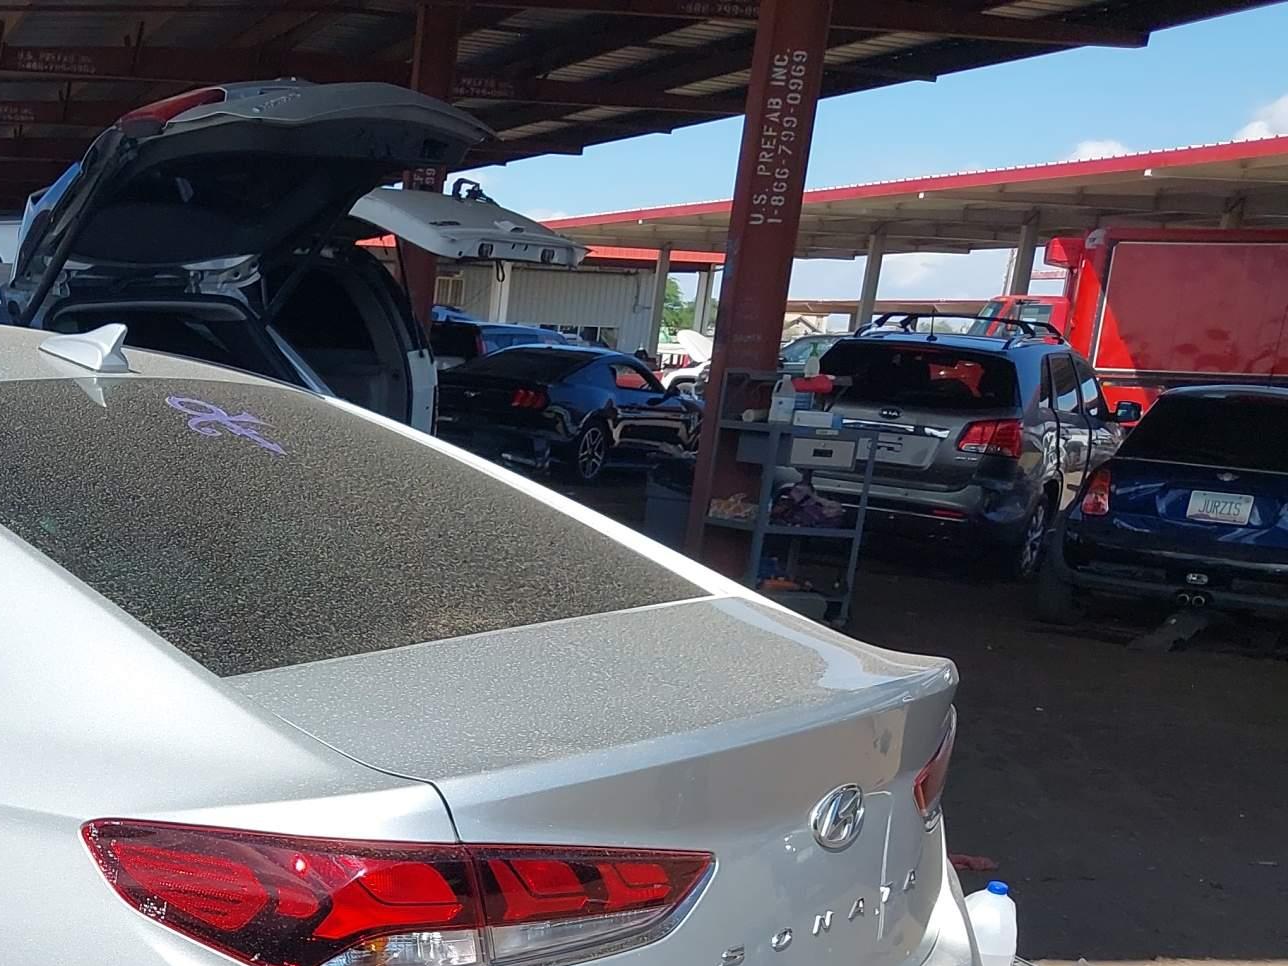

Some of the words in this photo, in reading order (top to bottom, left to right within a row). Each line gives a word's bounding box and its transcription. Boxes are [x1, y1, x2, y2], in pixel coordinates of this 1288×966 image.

[770, 48, 791, 86] INC.
[757, 97, 782, 176] PREFAB
[767, 50, 808, 224] 1-866-799-0969
[749, 188, 769, 225] U.S.
